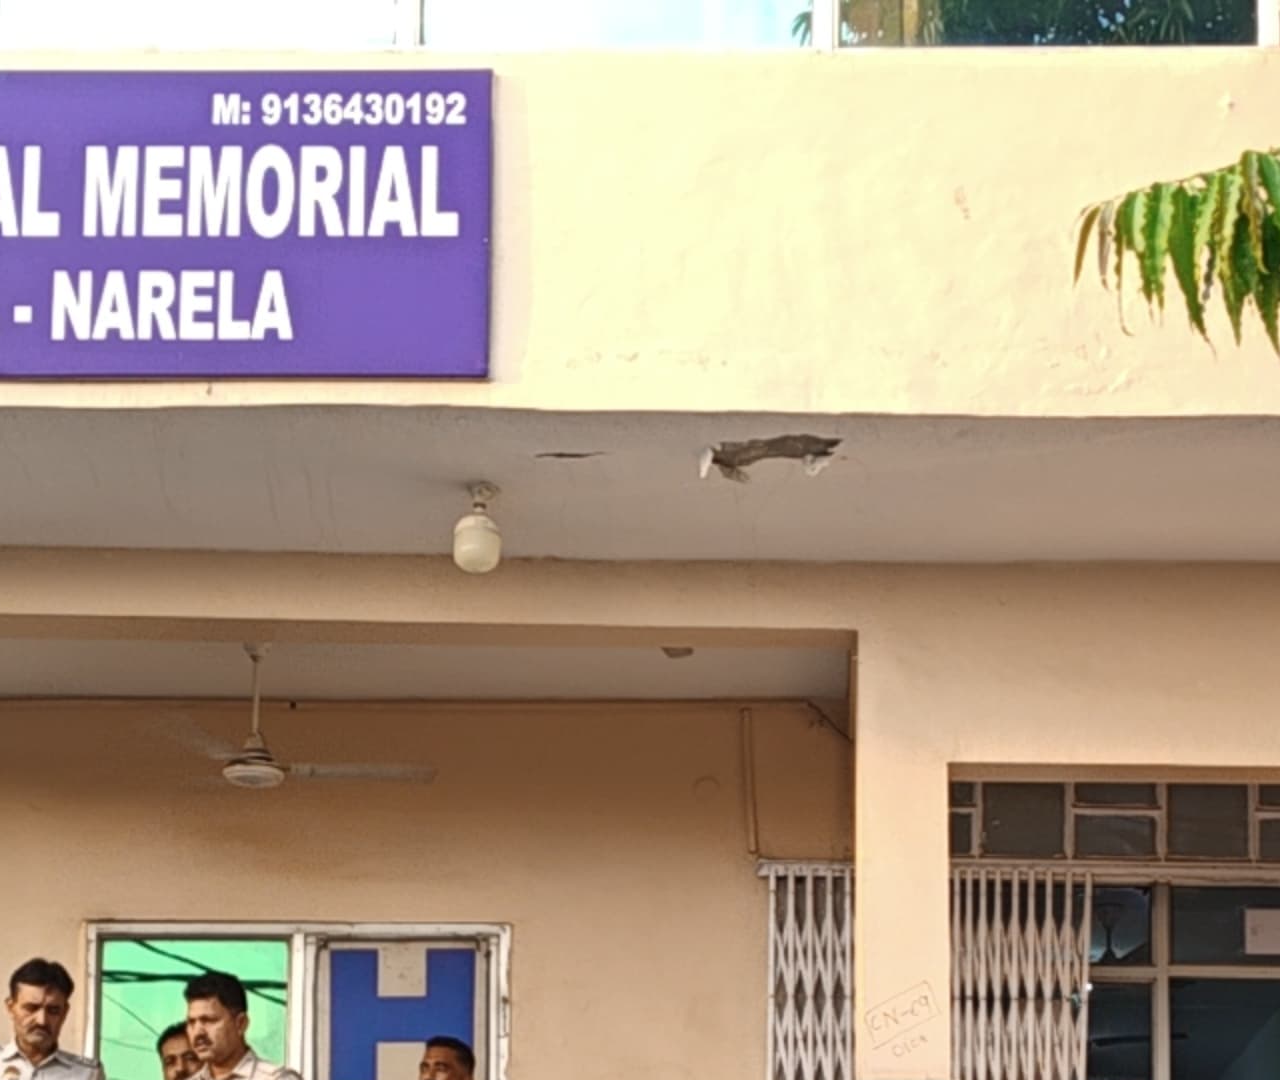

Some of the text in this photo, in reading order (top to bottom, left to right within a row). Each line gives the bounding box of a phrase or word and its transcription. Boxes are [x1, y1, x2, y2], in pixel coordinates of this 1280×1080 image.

[211, 92, 466, 125] M: 9136430192
[82, 144, 459, 238] MEMORIAL
[51, 270, 293, 340] NARELA
